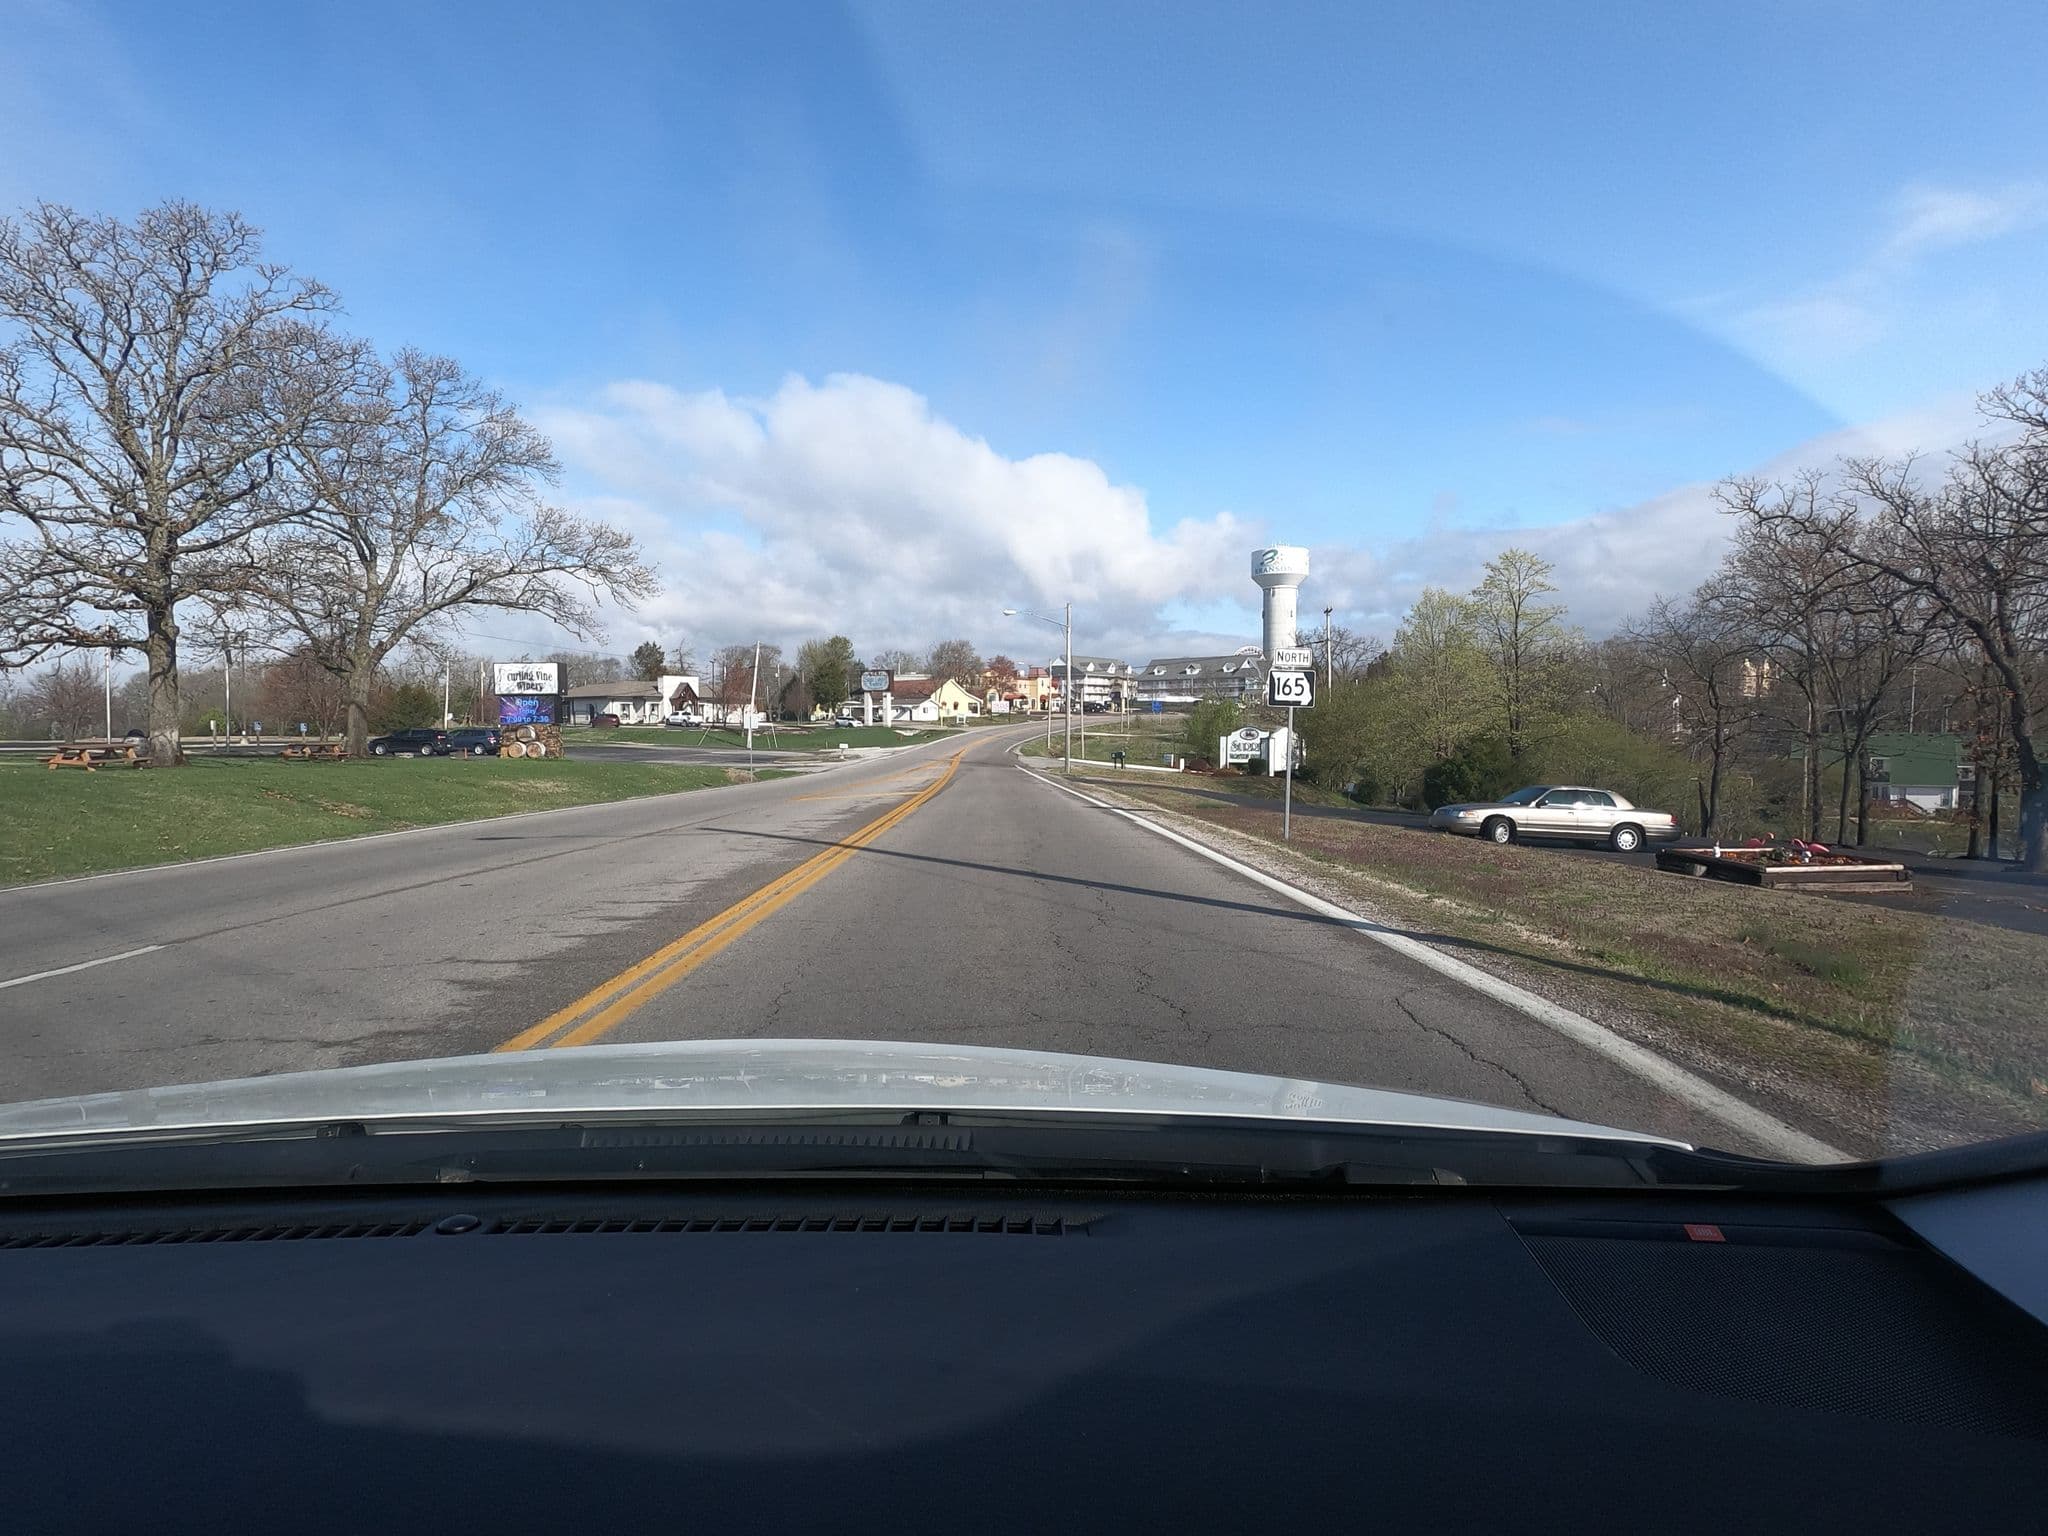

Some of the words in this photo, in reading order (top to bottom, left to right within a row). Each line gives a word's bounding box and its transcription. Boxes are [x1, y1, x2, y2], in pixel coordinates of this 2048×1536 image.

[1277, 651, 1309, 663] NORTH
[1277, 677, 1304, 696] 165
[515, 698, 538, 706] Open
